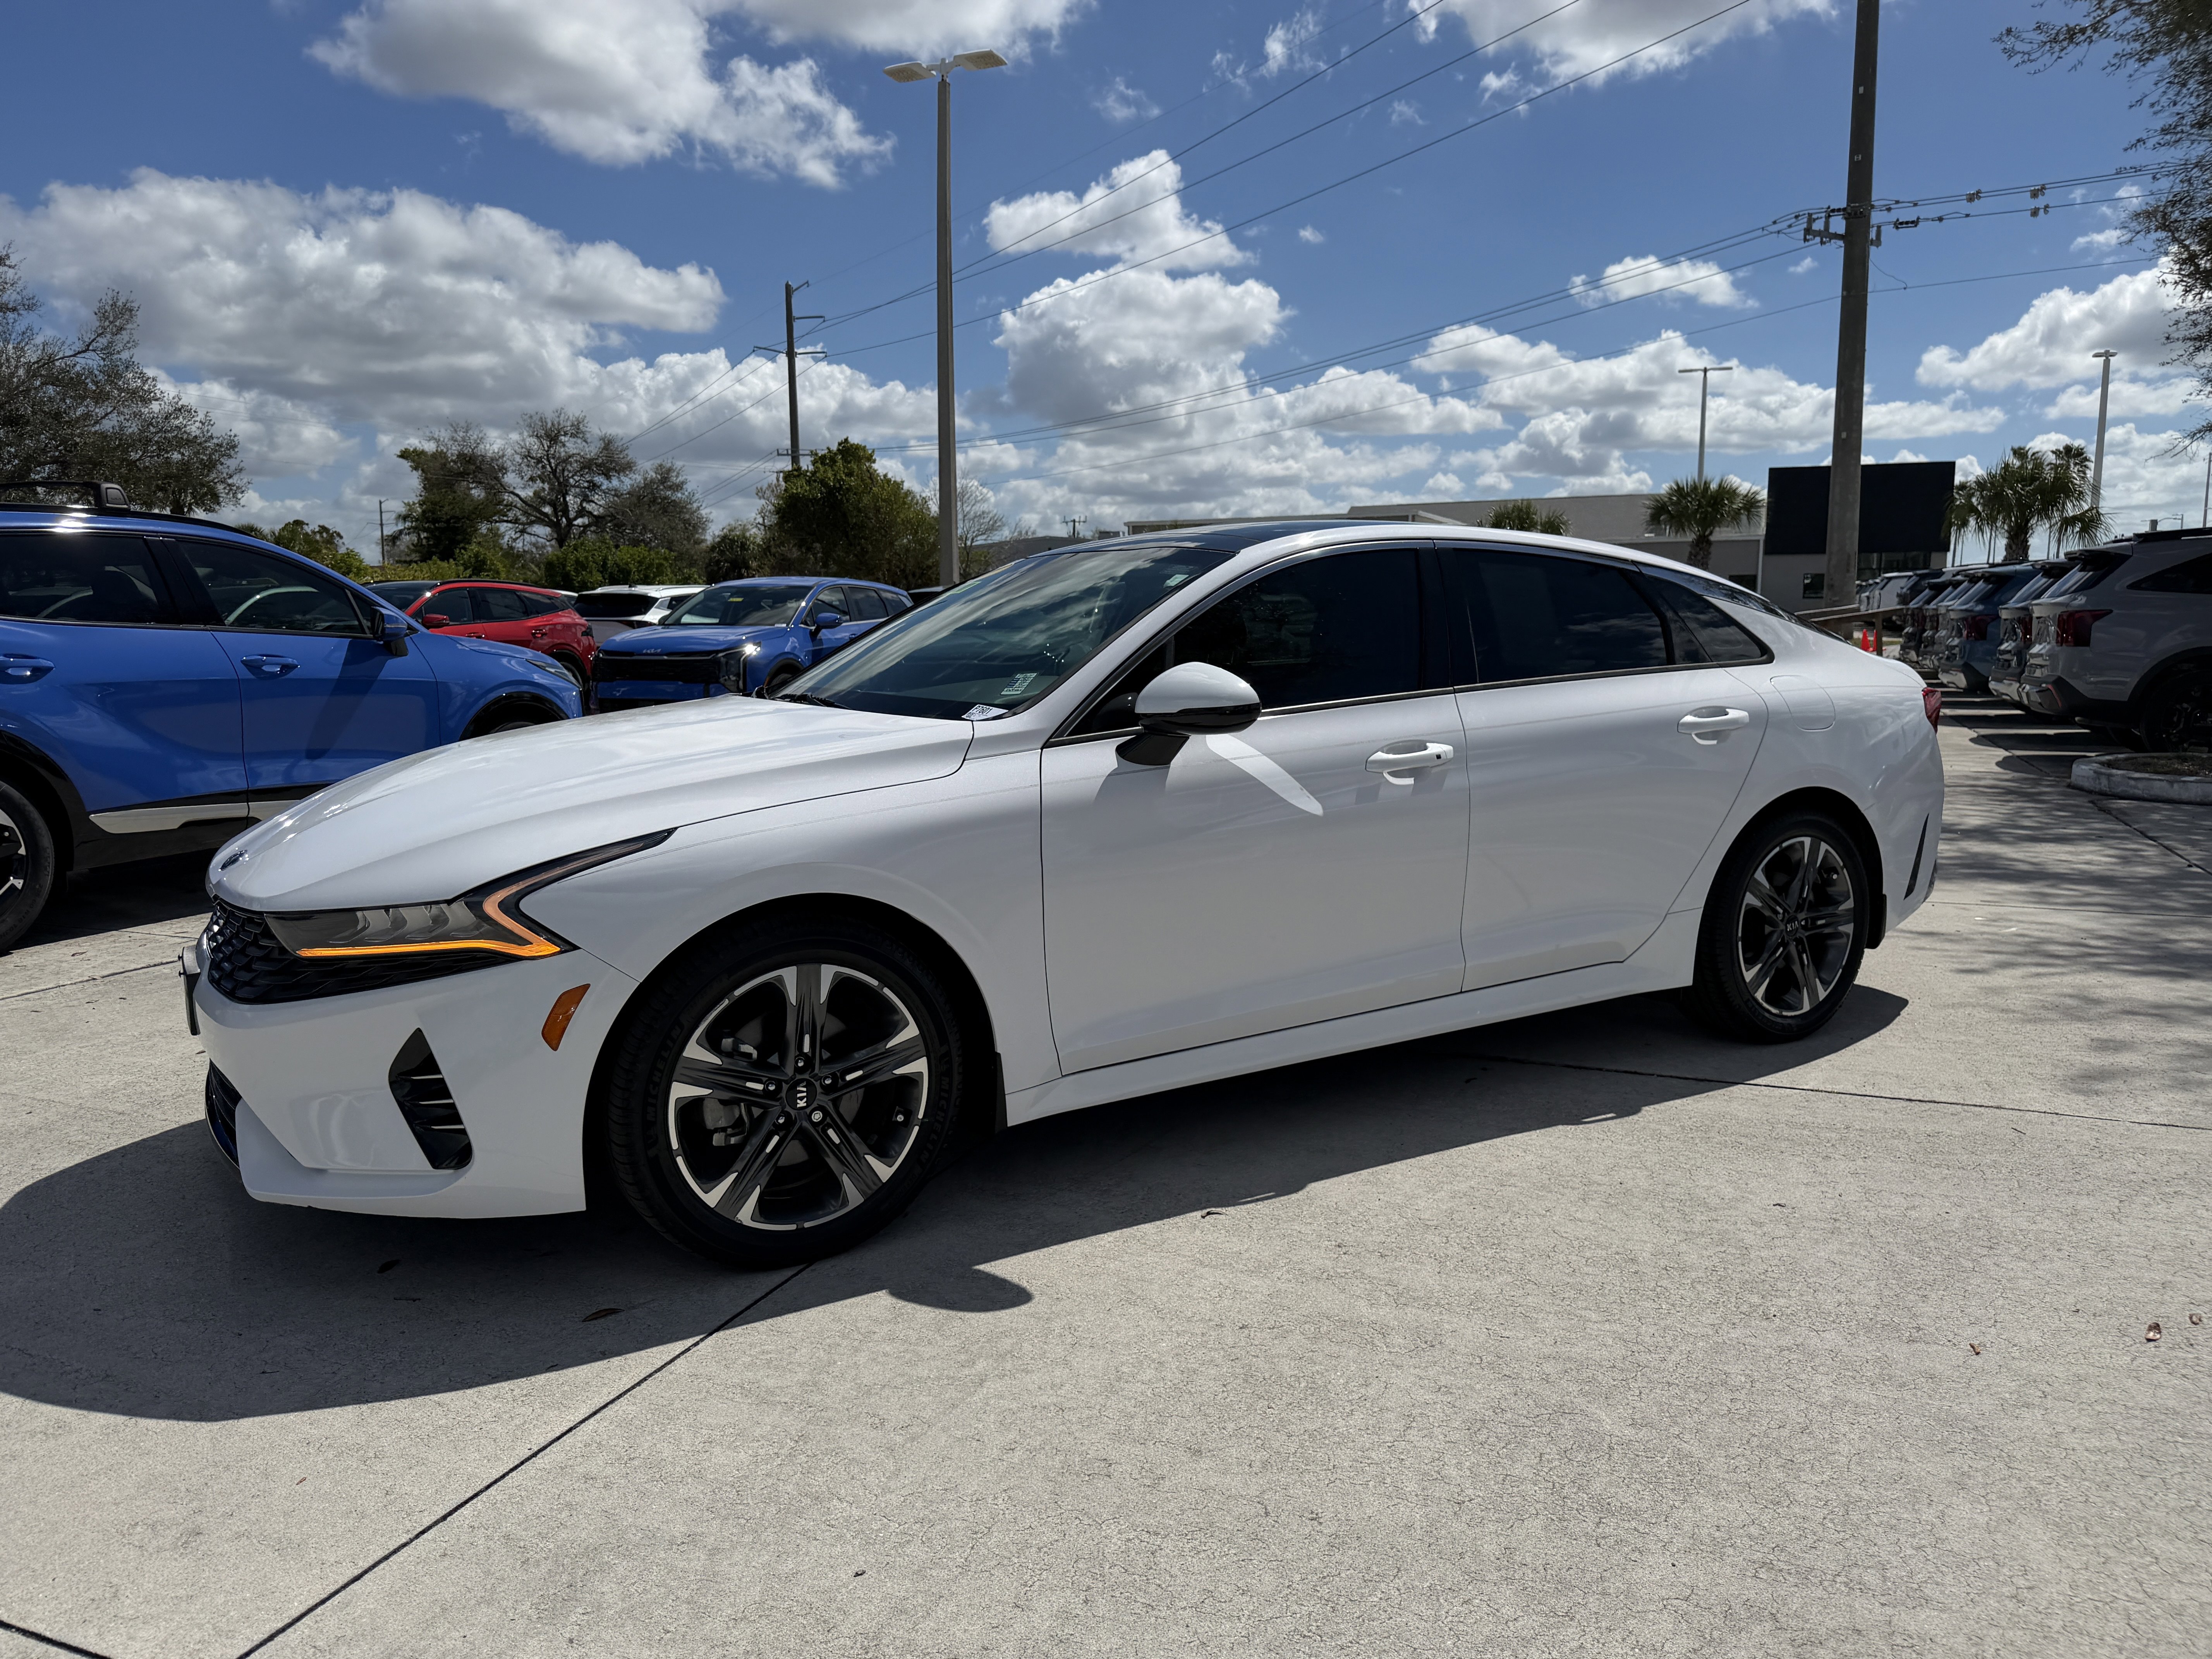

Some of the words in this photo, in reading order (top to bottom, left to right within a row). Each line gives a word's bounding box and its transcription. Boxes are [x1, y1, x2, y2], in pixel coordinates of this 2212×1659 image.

[972, 706, 993, 714] P7601
[1787, 921, 1798, 931] KIA
[646, 1024, 682, 1122] MICHELIN
[797, 1081, 807, 1108] KIA
[920, 1076, 950, 1163] MICHELIN
